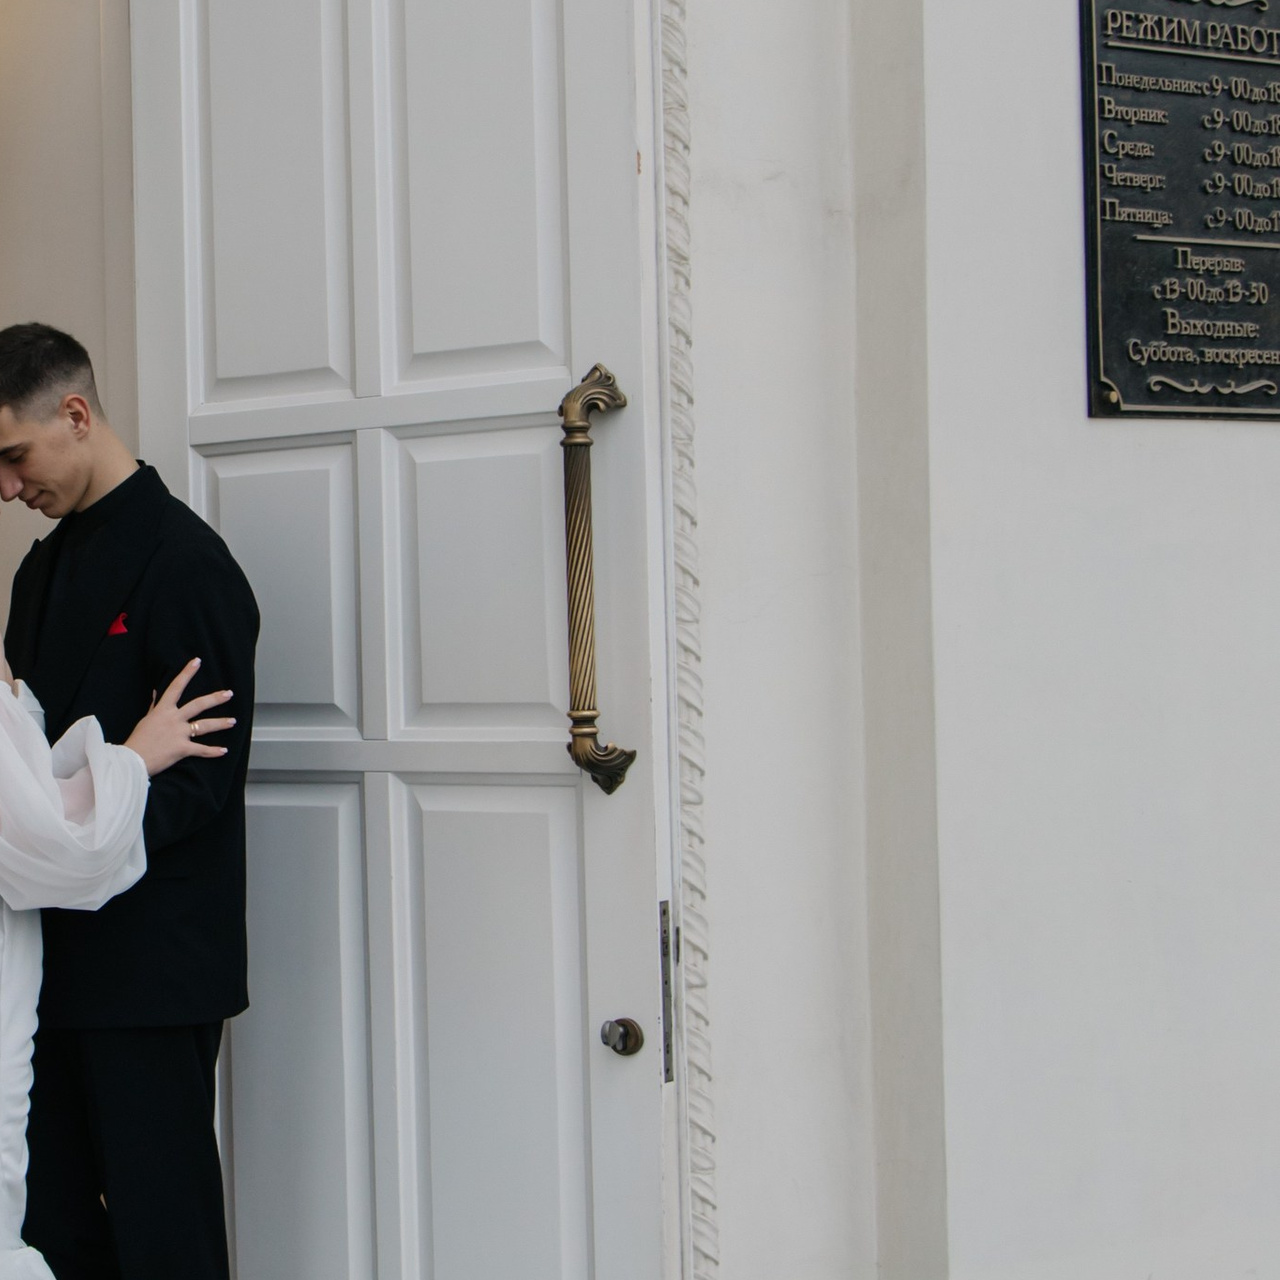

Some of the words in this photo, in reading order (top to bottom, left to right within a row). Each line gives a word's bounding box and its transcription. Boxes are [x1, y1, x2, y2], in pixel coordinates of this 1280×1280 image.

[1104, 8, 1201, 46] РЕЖИМ
[1205, 21, 1280, 56] РАБОТ
[1100, 62, 1201, 94] Понедельник:
[1251, 87, 1268, 102] до
[1100, 95, 1169, 125] Вторник:
[1253, 120, 1269, 135] до
[1102, 129, 1155, 159] Среда:
[1253, 153, 1270, 167] до
[1101, 163, 1166, 192] Четверг:
[1254, 184, 1271, 198] до
[1101, 198, 1173, 228] Пятница:
[1255, 218, 1272, 233] до
[1174, 247, 1245, 276] Перерыв:
[1207, 287, 1224, 303] до
[1162, 308, 1260, 339] Выходные:
[1127, 338, 1200, 366] Суббота,
[1202, 347, 1280, 369] воскресен
